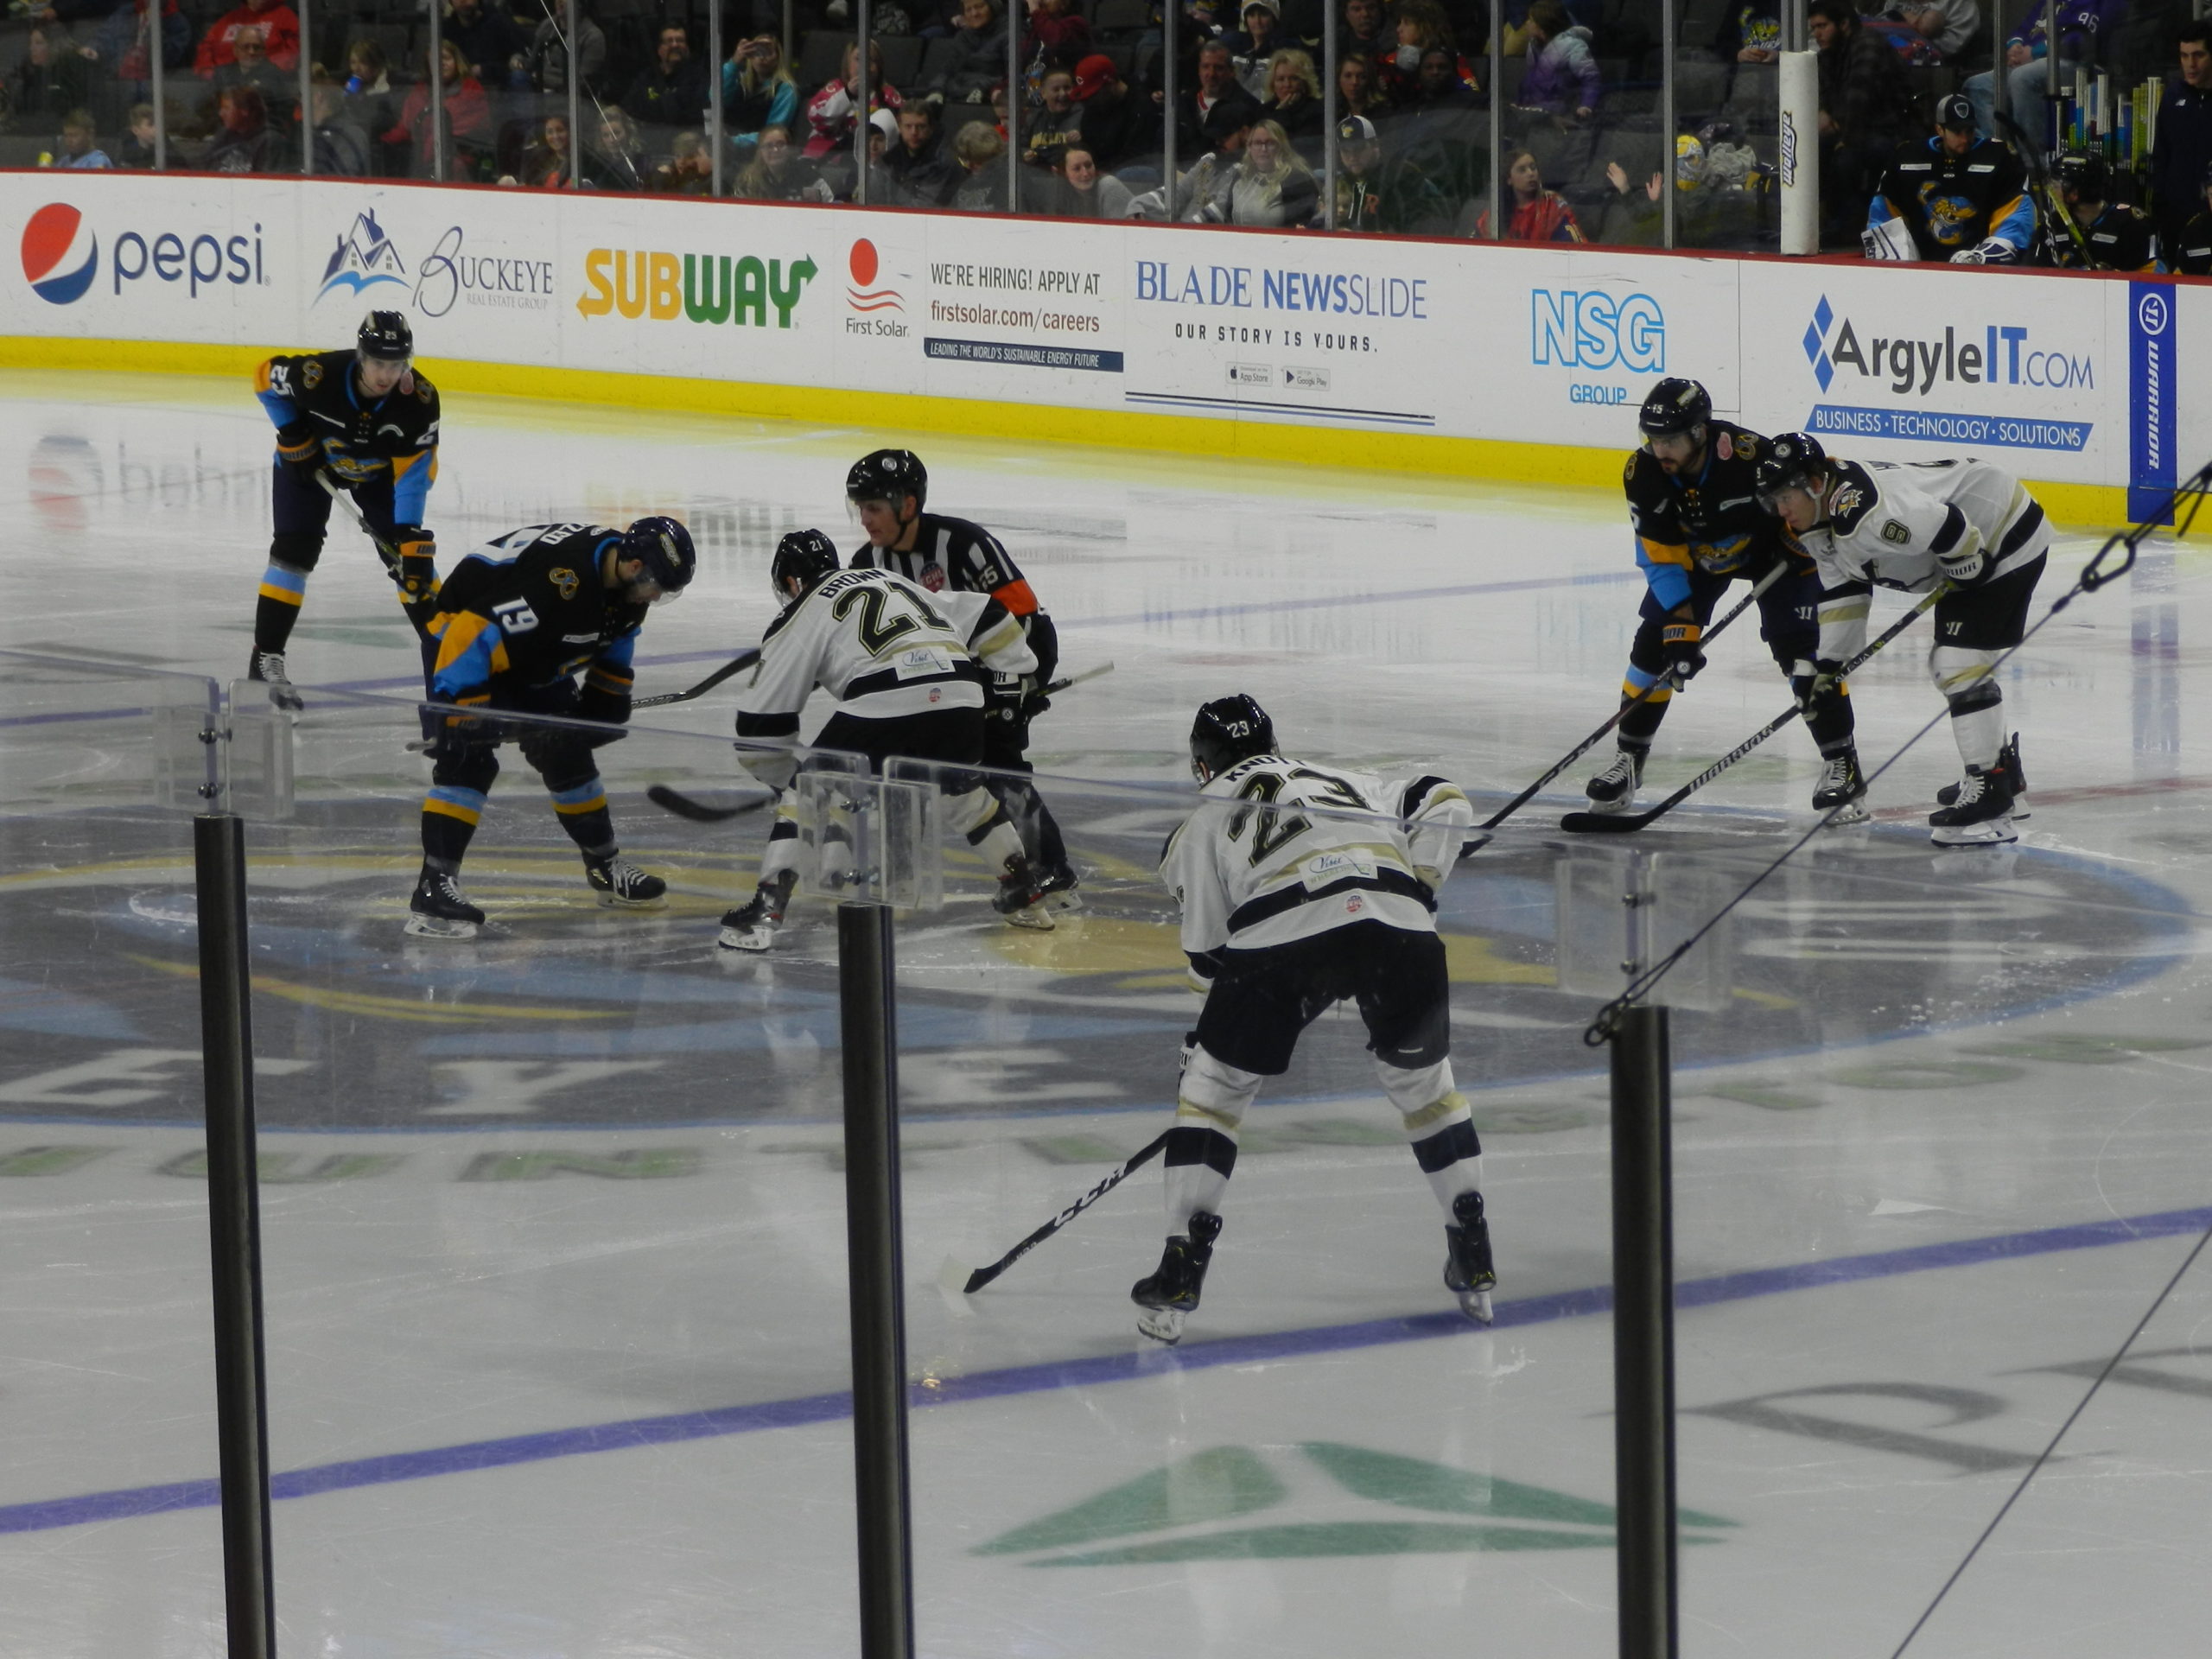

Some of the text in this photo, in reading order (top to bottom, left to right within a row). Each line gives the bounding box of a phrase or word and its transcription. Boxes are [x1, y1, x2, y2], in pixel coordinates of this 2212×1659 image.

[114, 222, 264, 298] pepsi
[576, 247, 818, 329] SUBWAY
[931, 263, 1101, 296] WE'RE HIRING! APPLY AT
[1134, 260, 1252, 308] BLADE
[467, 293, 549, 311] REAL ESTATE GROUP
[931, 300, 1100, 333] firstsolar.com/careers
[845, 317, 872, 335] First
[1175, 322, 1378, 353] OUR STORY IS YOURS.
[1532, 289, 1666, 372] NSG
[931, 342, 1100, 368] LEADING THE WORLD'S SUSTAINABLE ENERGY FUTURE
[1240, 372, 1268, 383] App Store
[1569, 384, 1627, 406] GROUP
[2147, 340, 2160, 470] WARRIOR
[1816, 410, 2082, 447] BUSINESS TECHNOLOGY SOLUTIONS
[817, 569, 889, 600] BROWN
[832, 580, 955, 658] 21
[1229, 720, 1250, 739] 23
[1227, 767, 1380, 869] 23
